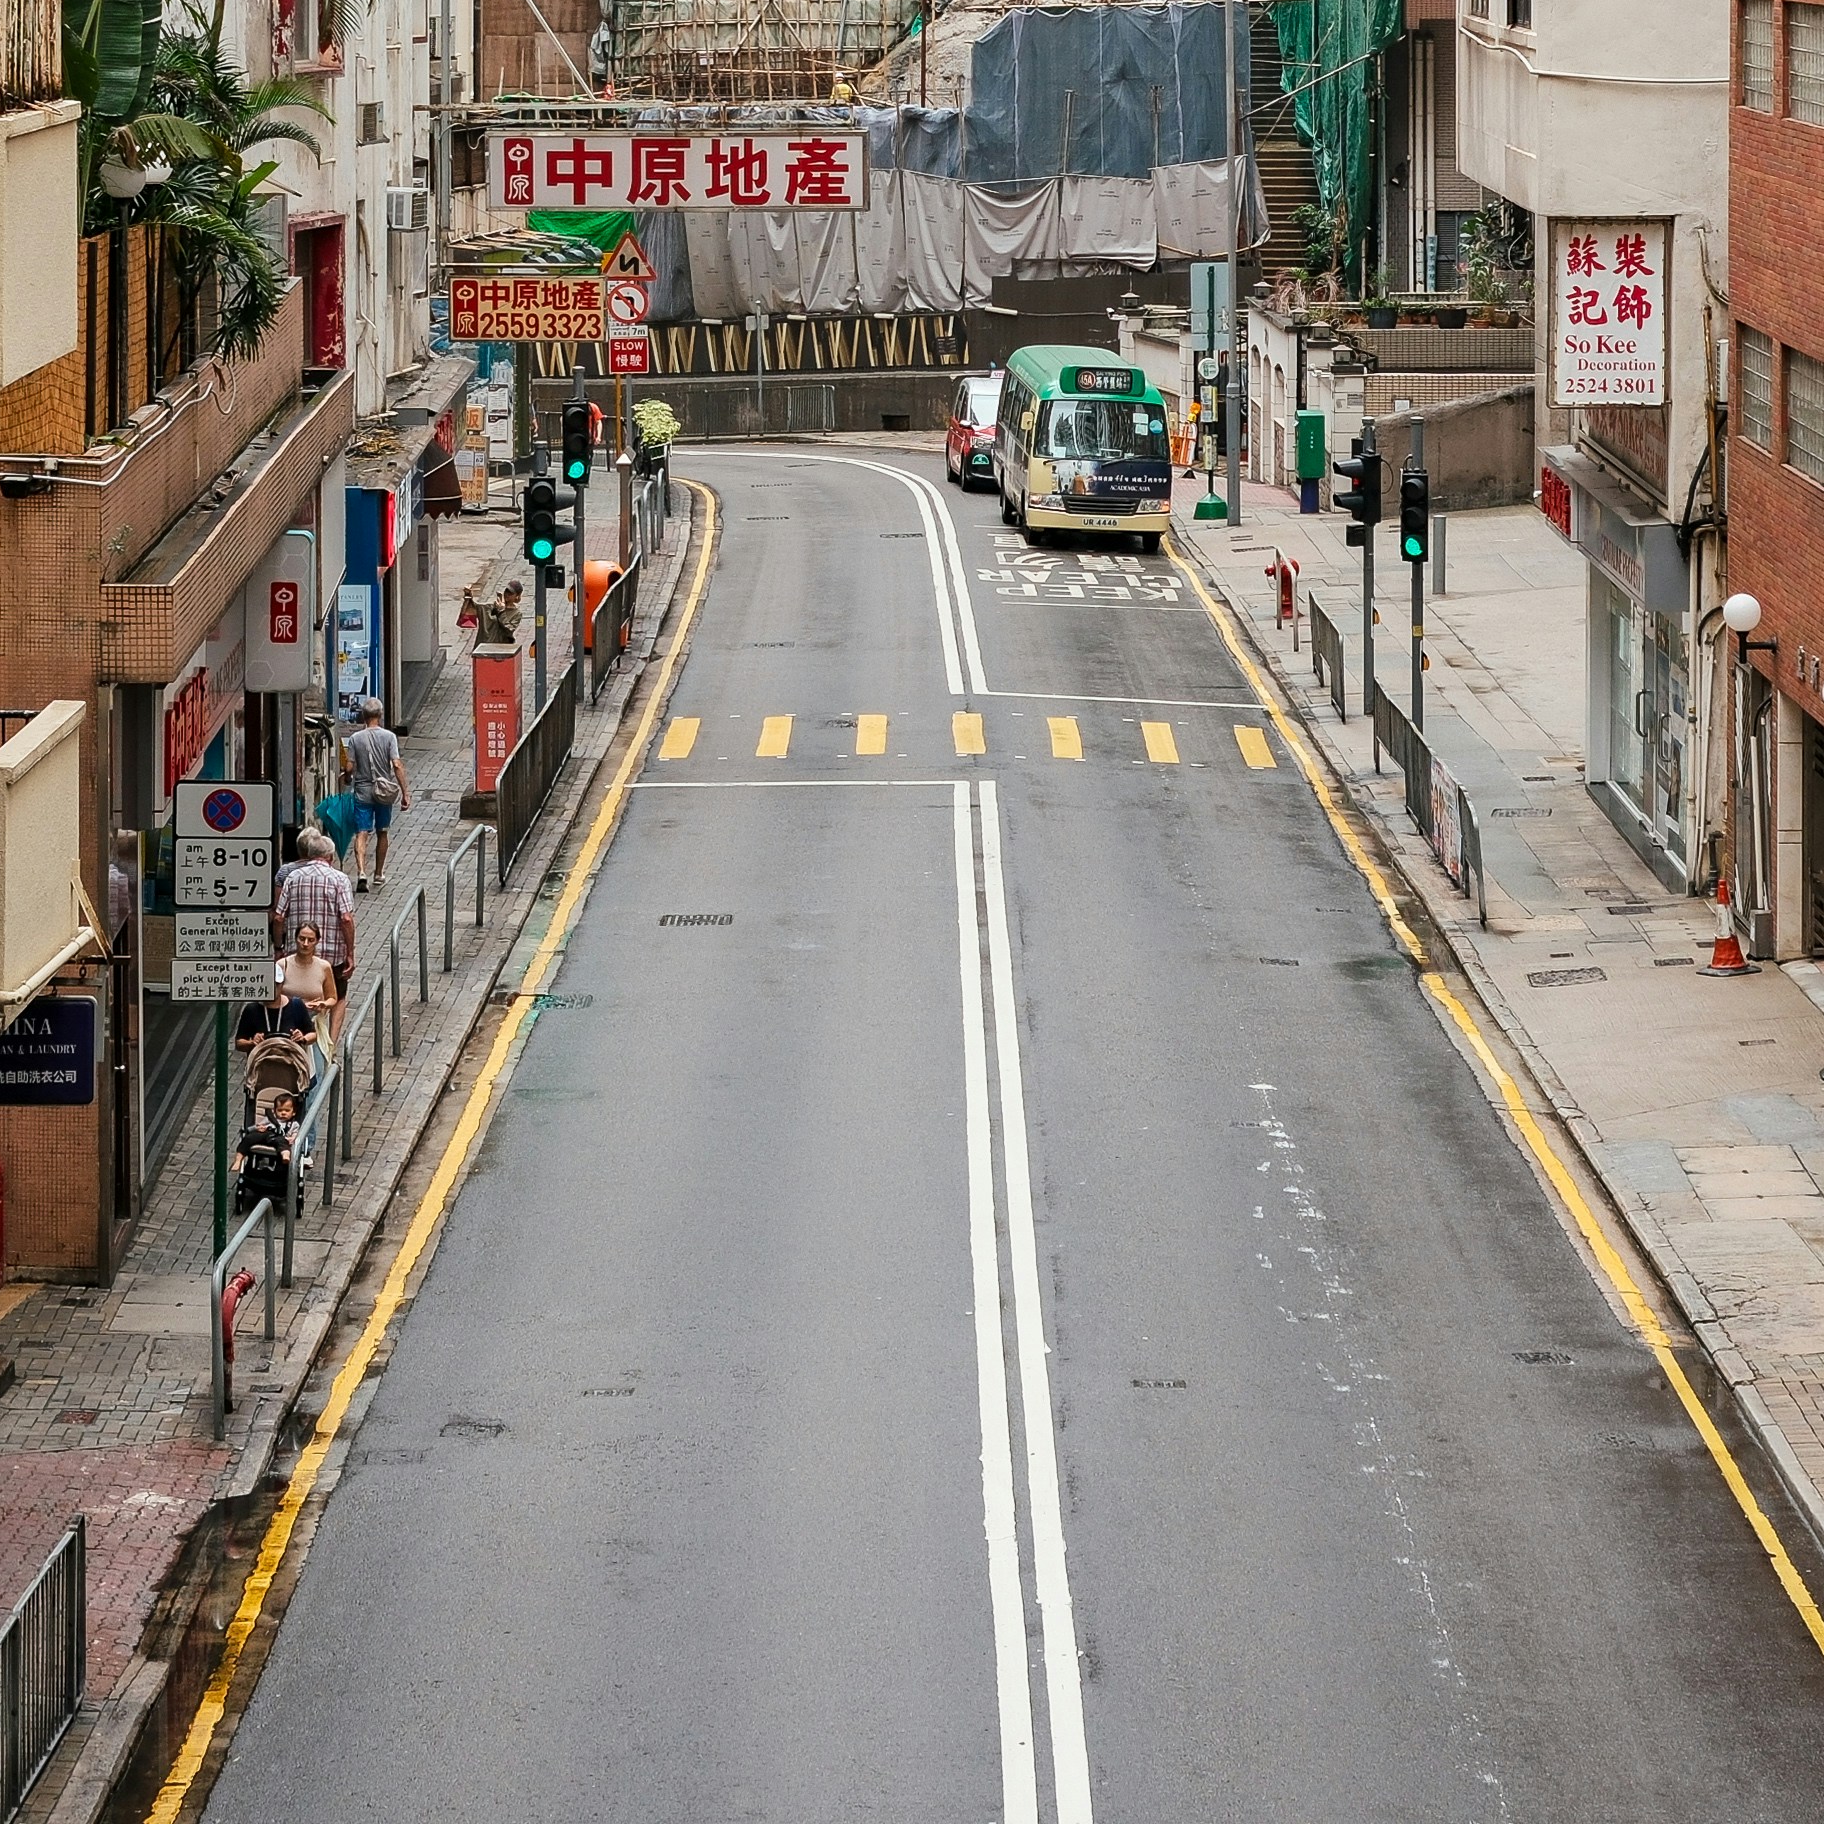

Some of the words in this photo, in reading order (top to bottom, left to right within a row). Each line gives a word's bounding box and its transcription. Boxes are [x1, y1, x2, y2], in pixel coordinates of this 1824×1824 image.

[546, 137, 851, 206] 中原地產
[1565, 233, 1608, 326] 蘇記
[1612, 232, 1655, 331] 裝飾
[480, 280, 602, 311] 中原地產
[613, 341, 644, 351] SLOW
[1564, 334, 1591, 354] So
[1595, 334, 1637, 354] Kee
[1577, 358, 1656, 372] Decoration
[1565, 378, 1608, 394] 2524
[1613, 378, 1655, 394] 3801
[976, 567, 1184, 589] CLEAR
[995, 583, 1180, 602] KEEP
[185, 844, 203, 854] am
[180, 855, 210, 869] 上午
[212, 847, 268, 867] 8-10
[185, 875, 204, 885] pm
[180, 887, 209, 900] 下午
[205, 916, 240, 927] Except
[179, 927, 219, 936] General
[222, 926, 265, 937] Holidays
[178, 939, 265, 953] 公眾假期例外
[195, 963, 230, 973] Except
[233, 963, 252, 972] taxi
[183, 974, 204, 985] pick
[207, 974, 246, 986] up/drop
[248, 974, 265, 984] off
[177, 986, 269, 999] 的士上落客除外
[29, 1044, 77, 1054] LAUNDRY
